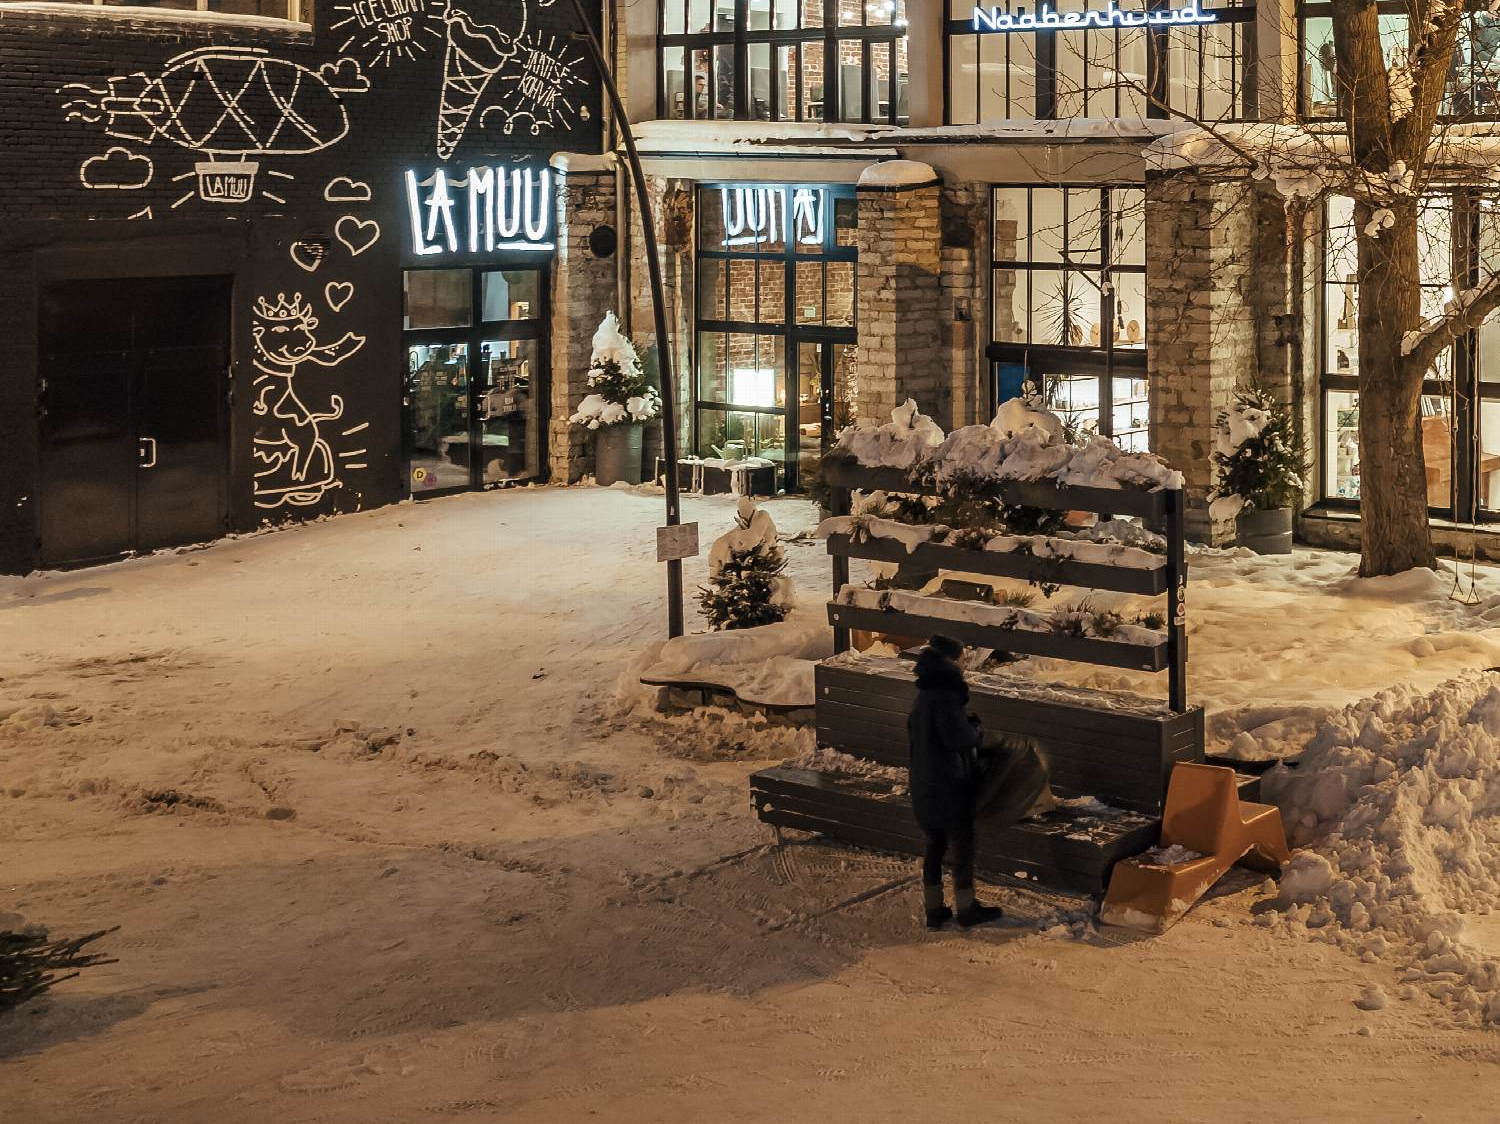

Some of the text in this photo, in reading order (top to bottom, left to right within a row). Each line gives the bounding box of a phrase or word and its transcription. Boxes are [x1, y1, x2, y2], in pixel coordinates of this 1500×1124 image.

[378, 17, 412, 46] SHOP
[206, 175, 247, 197] LA MUU
[405, 166, 555, 256] LA MUU
